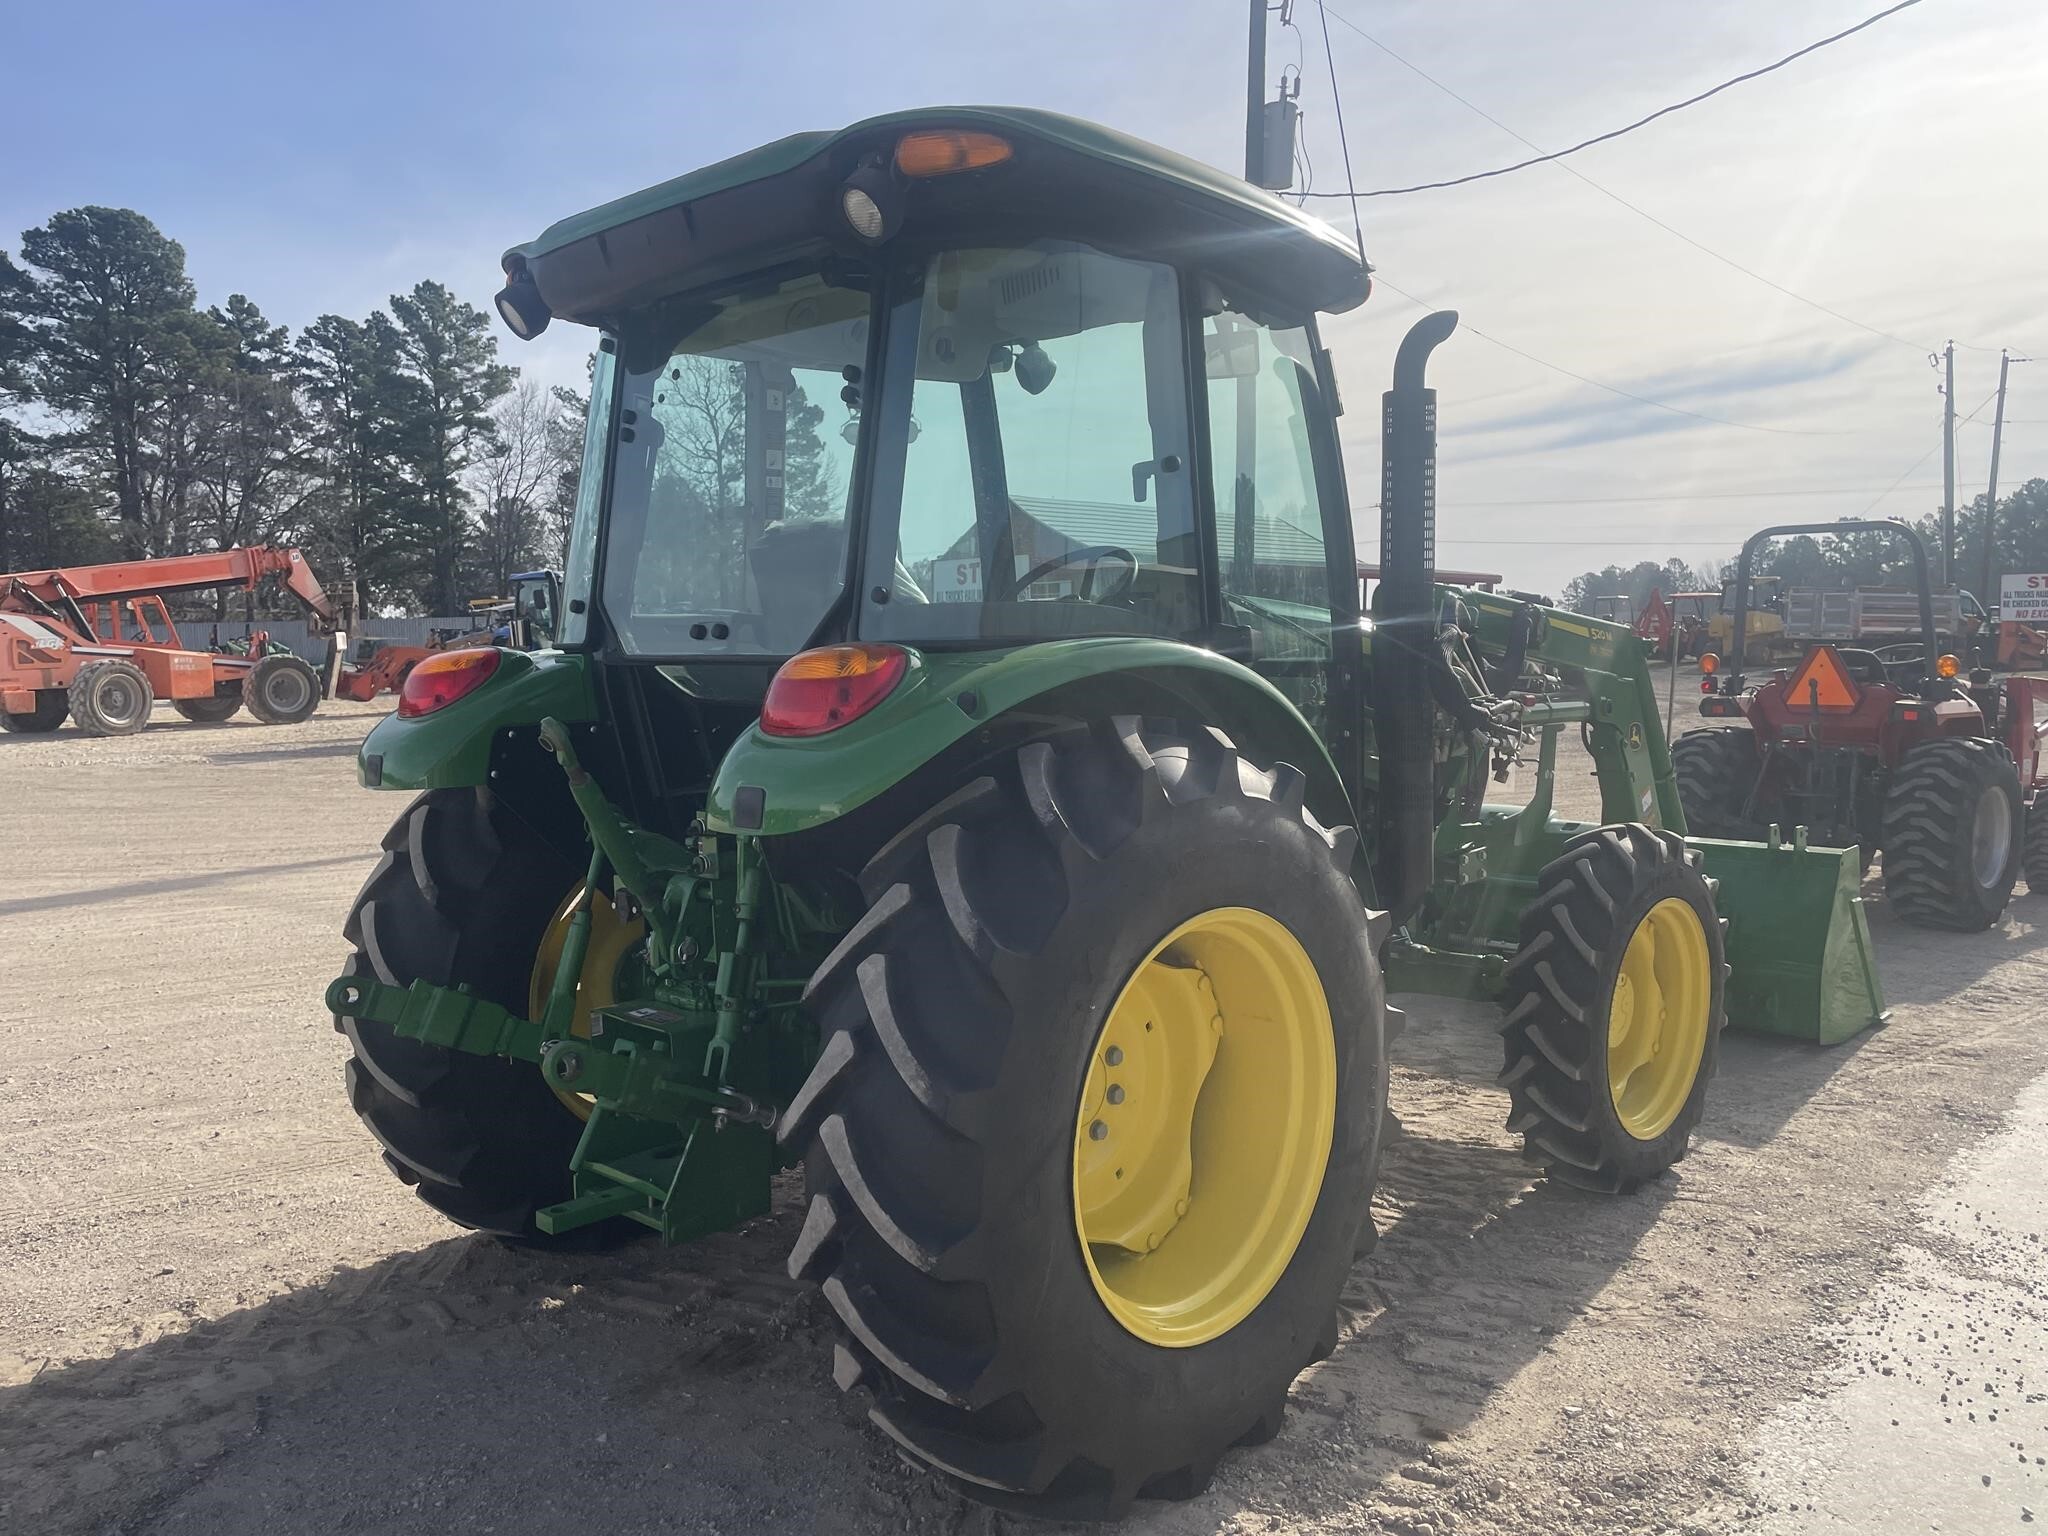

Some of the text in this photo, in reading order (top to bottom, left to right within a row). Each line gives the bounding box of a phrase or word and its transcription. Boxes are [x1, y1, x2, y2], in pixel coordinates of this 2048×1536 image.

[956, 562, 980, 585] ST
[2027, 576, 2048, 589] ST
[2014, 591, 2035, 599] TRUCKS
[2012, 600, 2039, 608] CHECKED
[2016, 610, 2029, 619] NO
